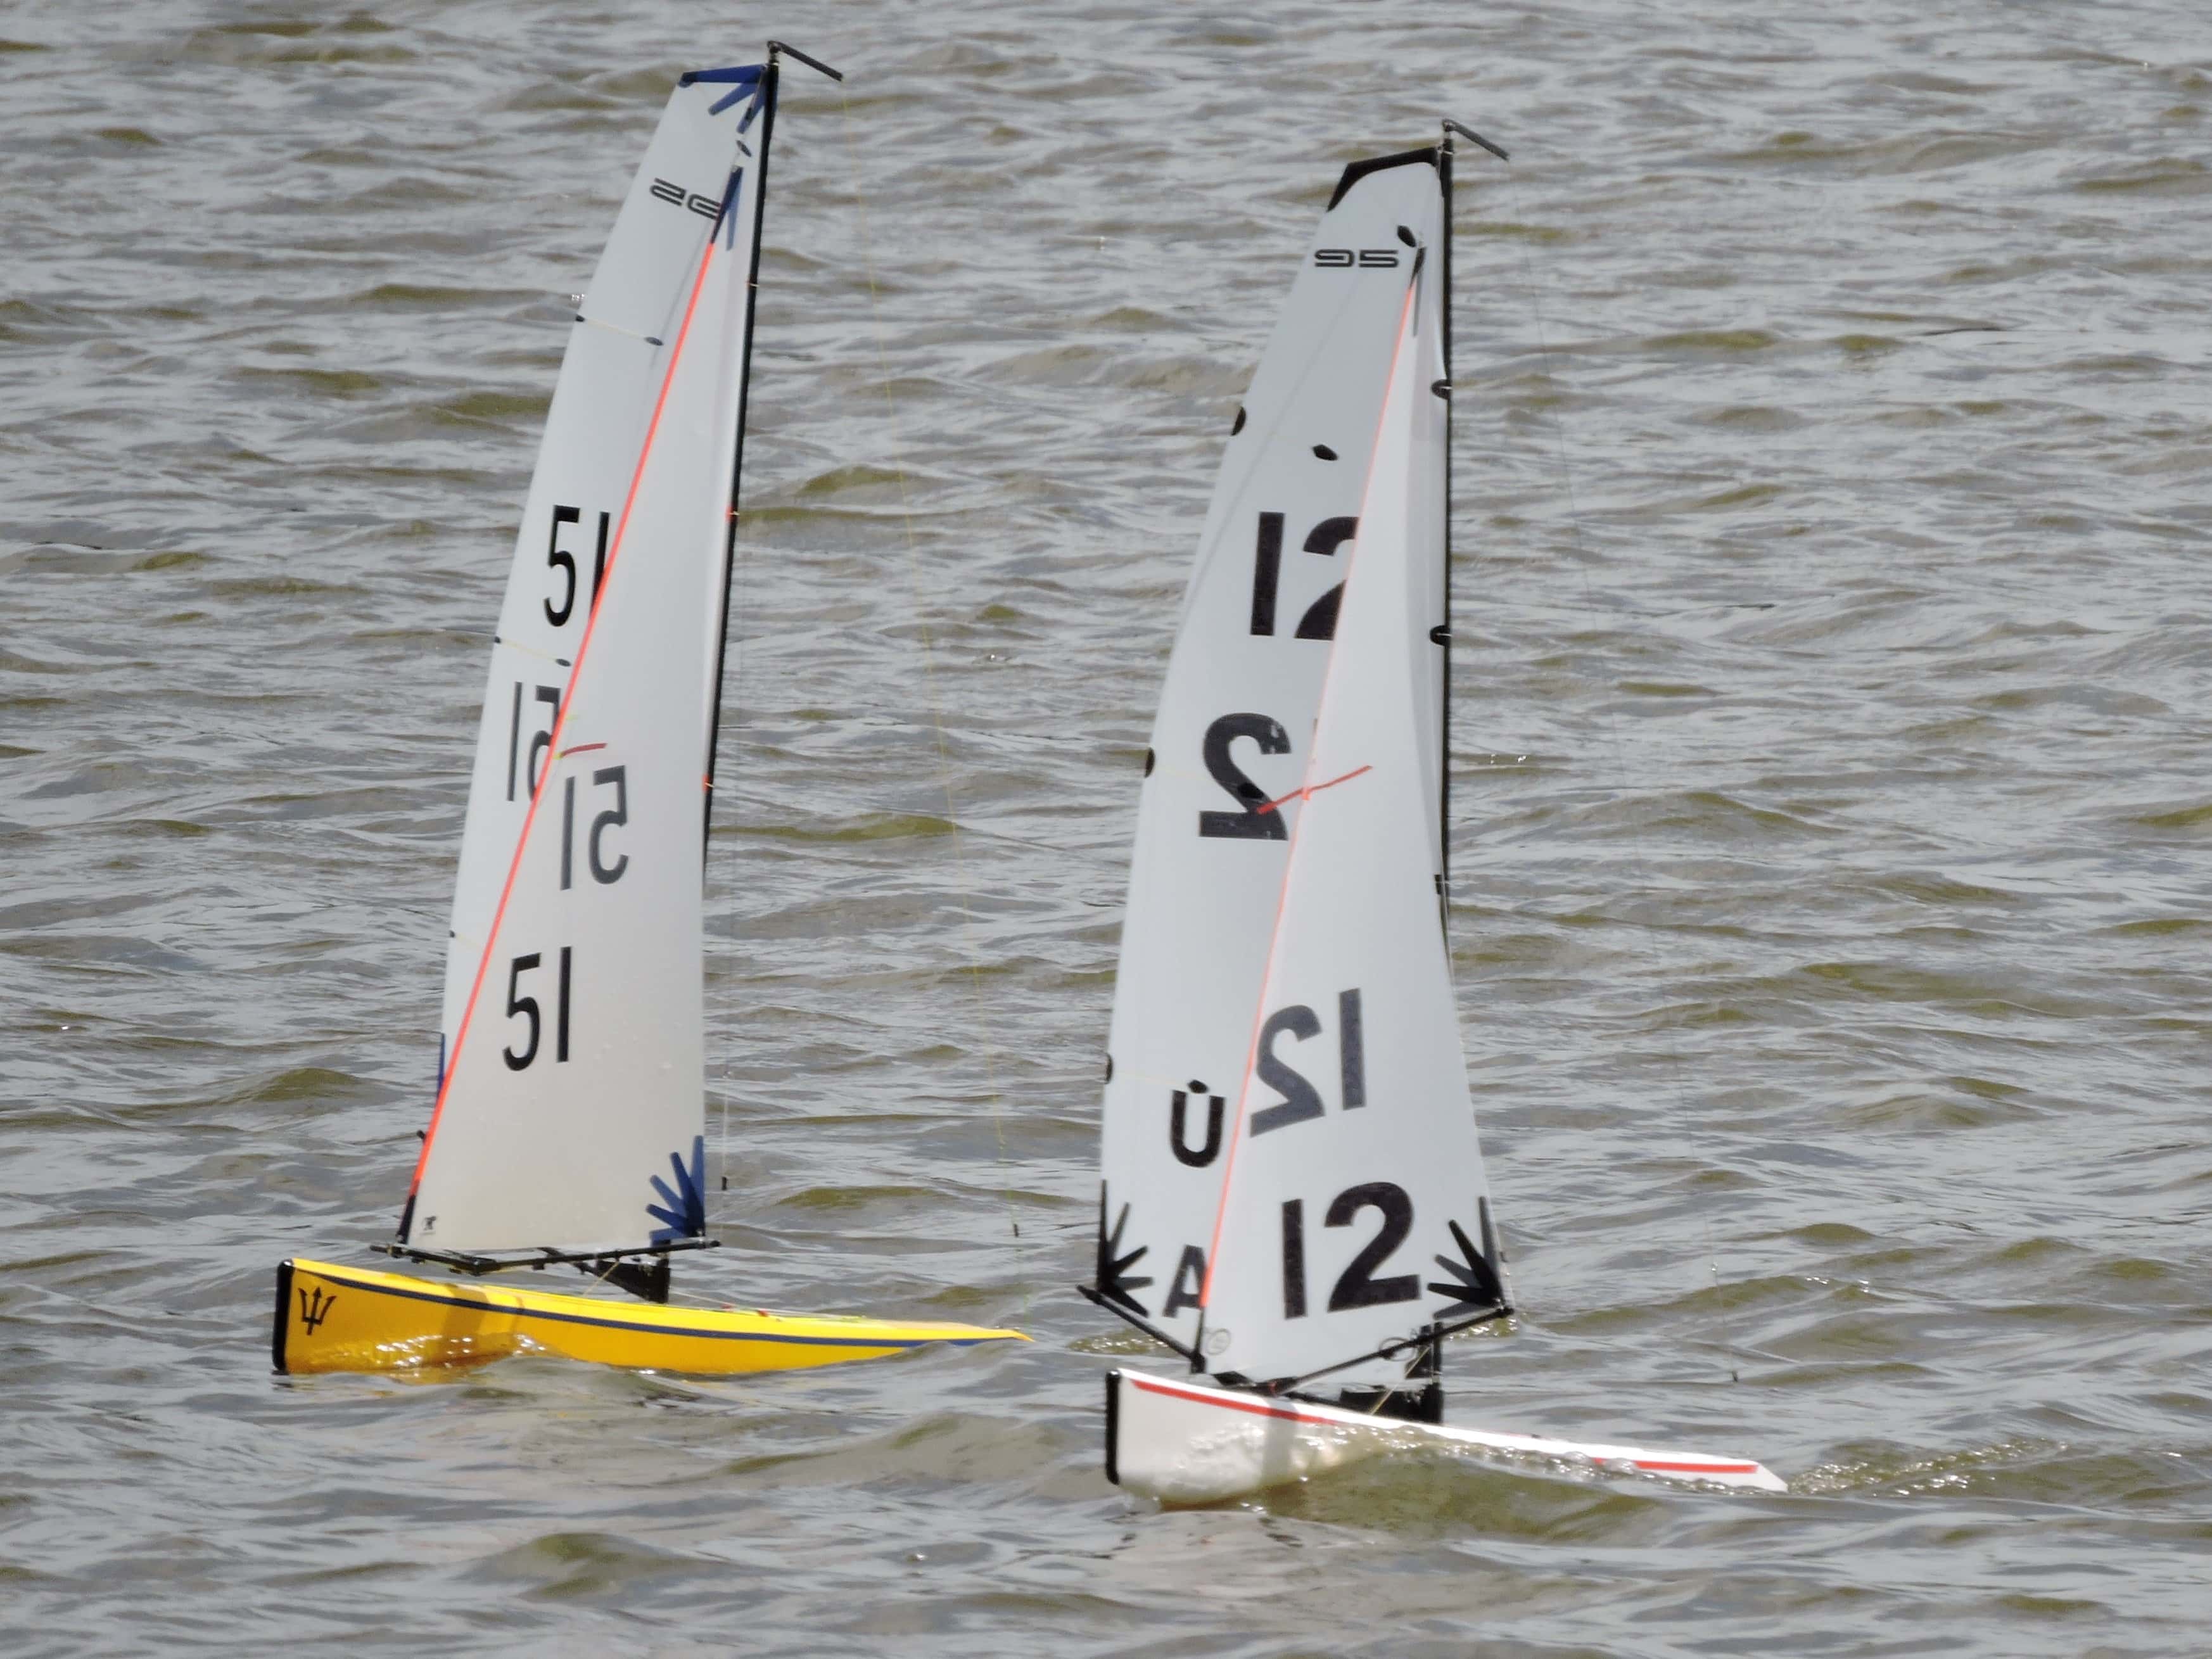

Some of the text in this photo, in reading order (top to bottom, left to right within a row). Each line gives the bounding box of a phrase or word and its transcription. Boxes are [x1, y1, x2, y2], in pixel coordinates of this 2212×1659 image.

[543, 505, 610, 626] 51
[502, 946, 572, 1071] 51
[1281, 1181, 1421, 1319] 12
